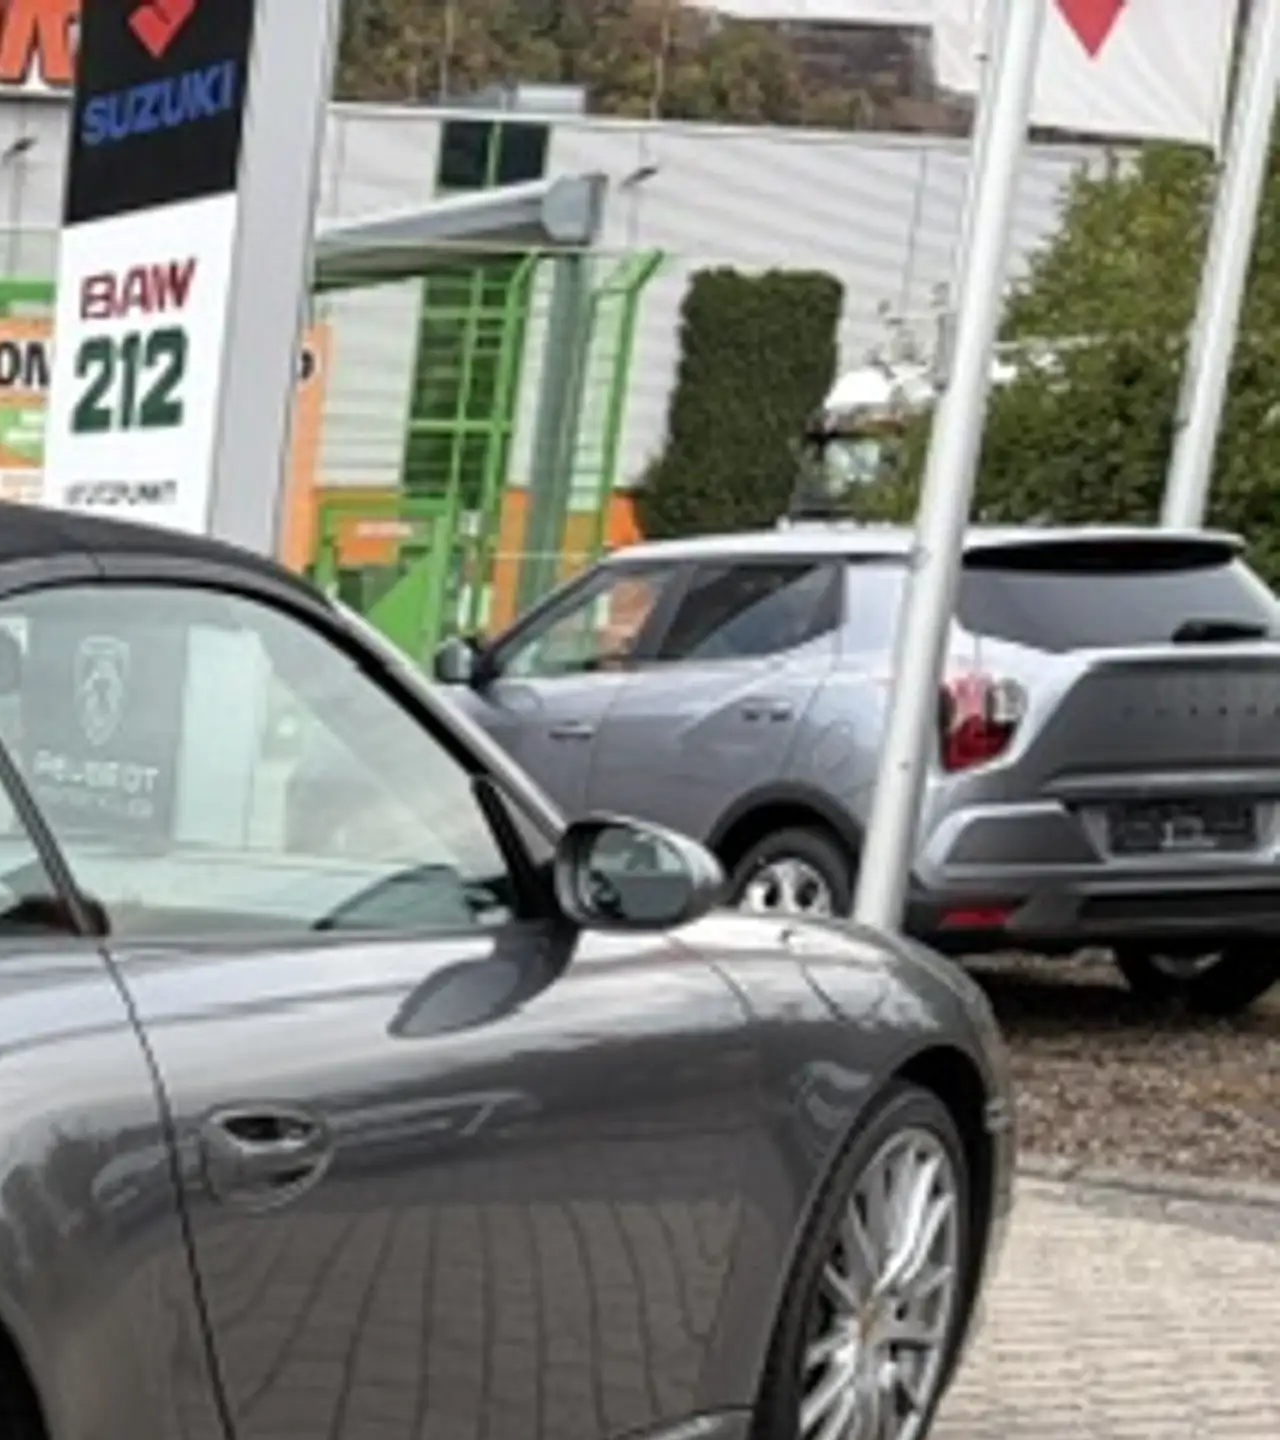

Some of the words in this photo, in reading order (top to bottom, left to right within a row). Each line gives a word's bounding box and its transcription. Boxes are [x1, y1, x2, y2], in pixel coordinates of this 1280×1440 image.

[81, 61, 236, 145] SUZUKI
[80, 257, 196, 319] BAW
[70, 326, 187, 433] 212
